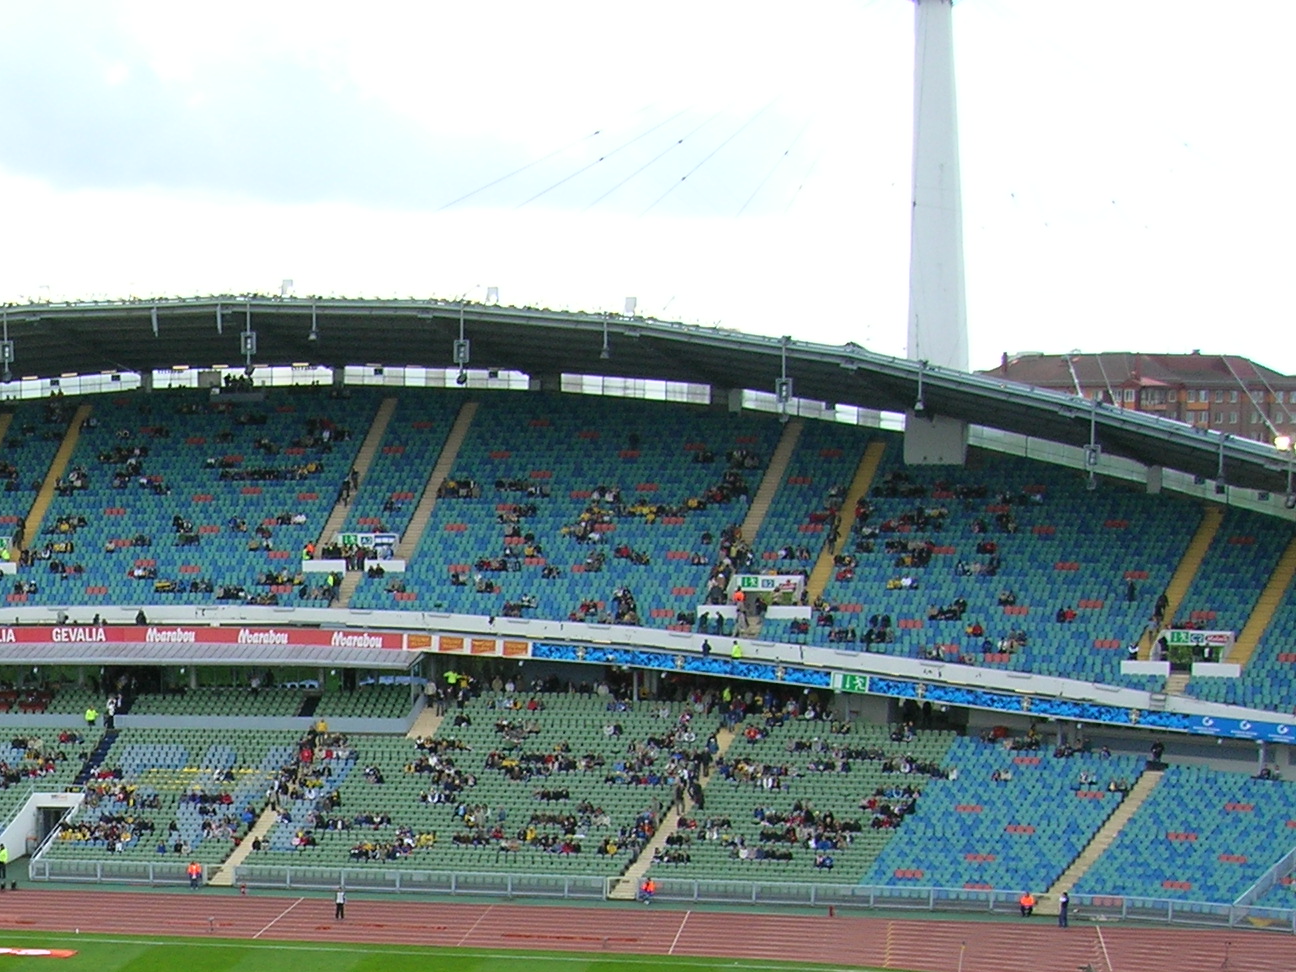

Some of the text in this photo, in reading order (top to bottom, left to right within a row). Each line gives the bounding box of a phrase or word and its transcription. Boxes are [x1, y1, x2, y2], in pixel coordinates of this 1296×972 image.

[51, 627, 106, 643] GEVALIA
[145, 627, 196, 643] Marabou
[237, 628, 289, 646] Marabou
[330, 631, 383, 649] Marabou
